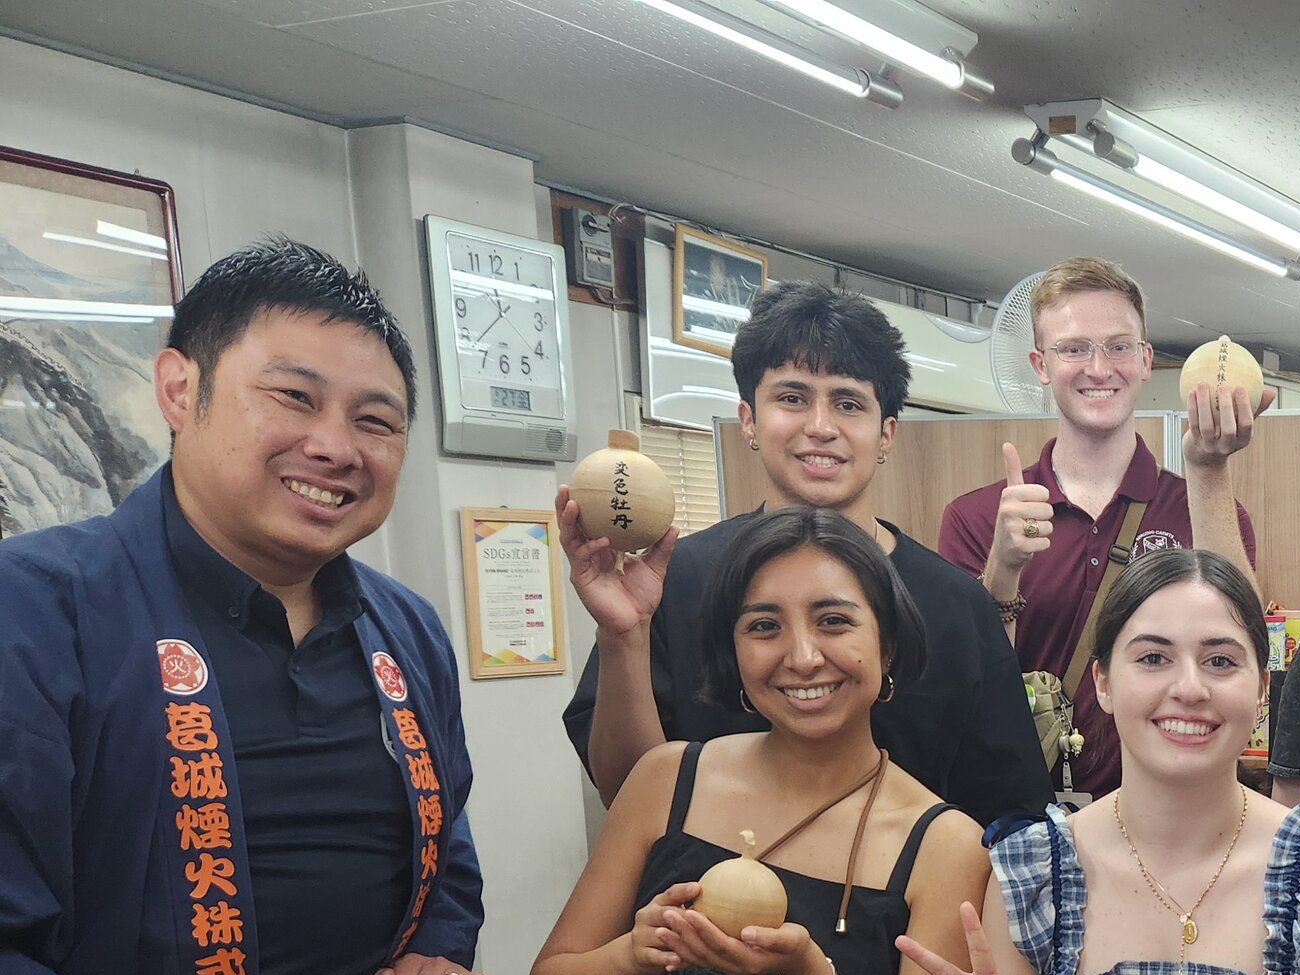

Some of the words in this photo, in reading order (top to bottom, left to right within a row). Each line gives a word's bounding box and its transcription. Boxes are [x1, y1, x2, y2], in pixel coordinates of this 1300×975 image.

[468, 252, 480, 273] 11
[489, 254, 503, 276] 12
[514, 262, 520, 280] 1
[455, 298, 467, 318] 9
[534, 312, 544, 332] 3
[479, 349, 488, 369] 7
[534, 340, 544, 360] 4
[500, 354, 510, 374] 6
[521, 356, 531, 375] 5
[610, 461, 633, 530] 変色牡丹
